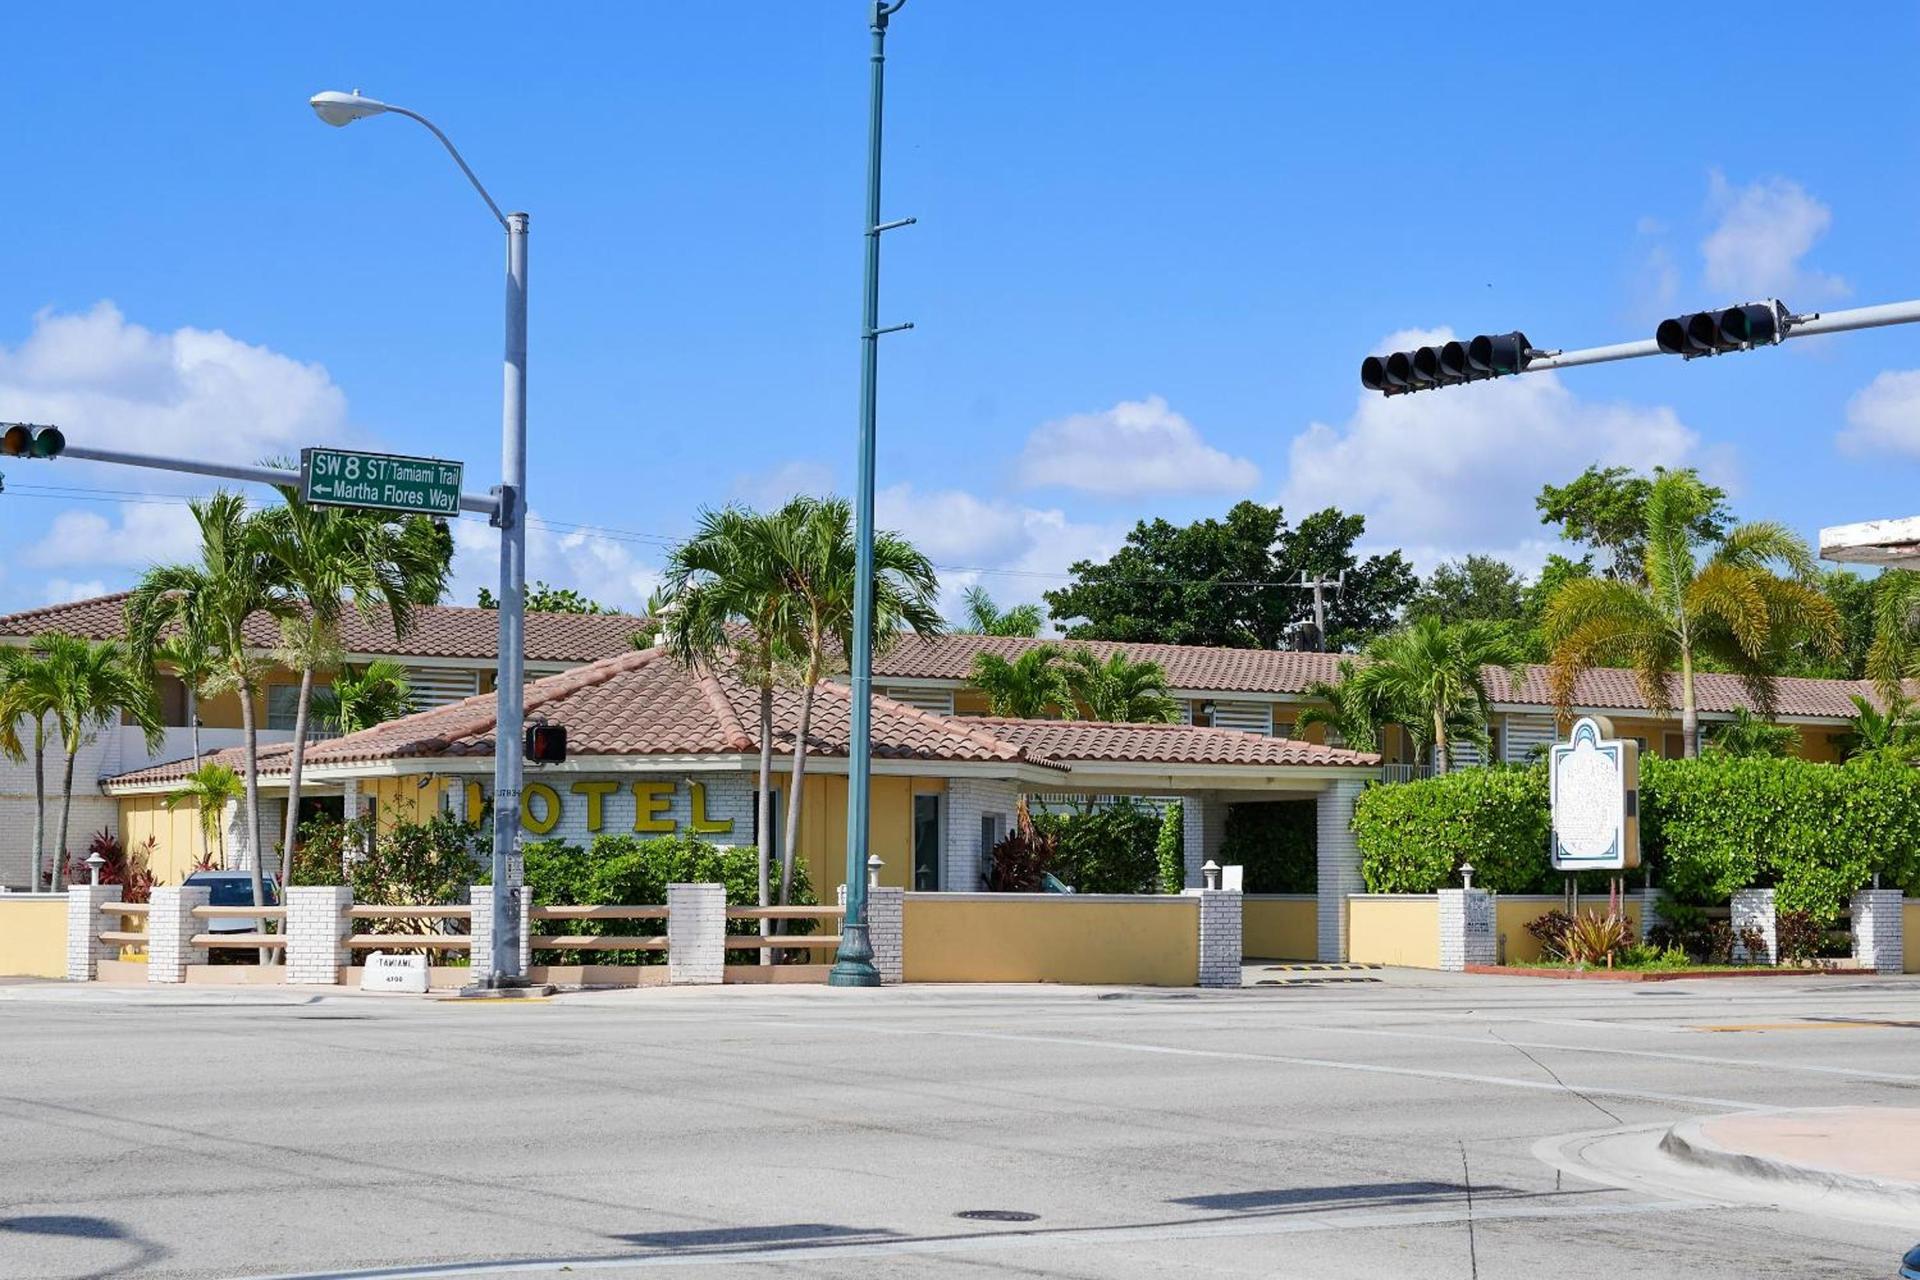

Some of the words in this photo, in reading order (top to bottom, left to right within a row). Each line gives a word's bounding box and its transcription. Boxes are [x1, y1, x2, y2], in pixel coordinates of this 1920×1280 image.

[316, 454, 340, 476] SW
[345, 457, 360, 480] 8
[439, 467, 459, 486] Trail
[333, 480, 379, 501] Martha
[384, 485, 424, 505] Flores
[429, 489, 456, 511] Way
